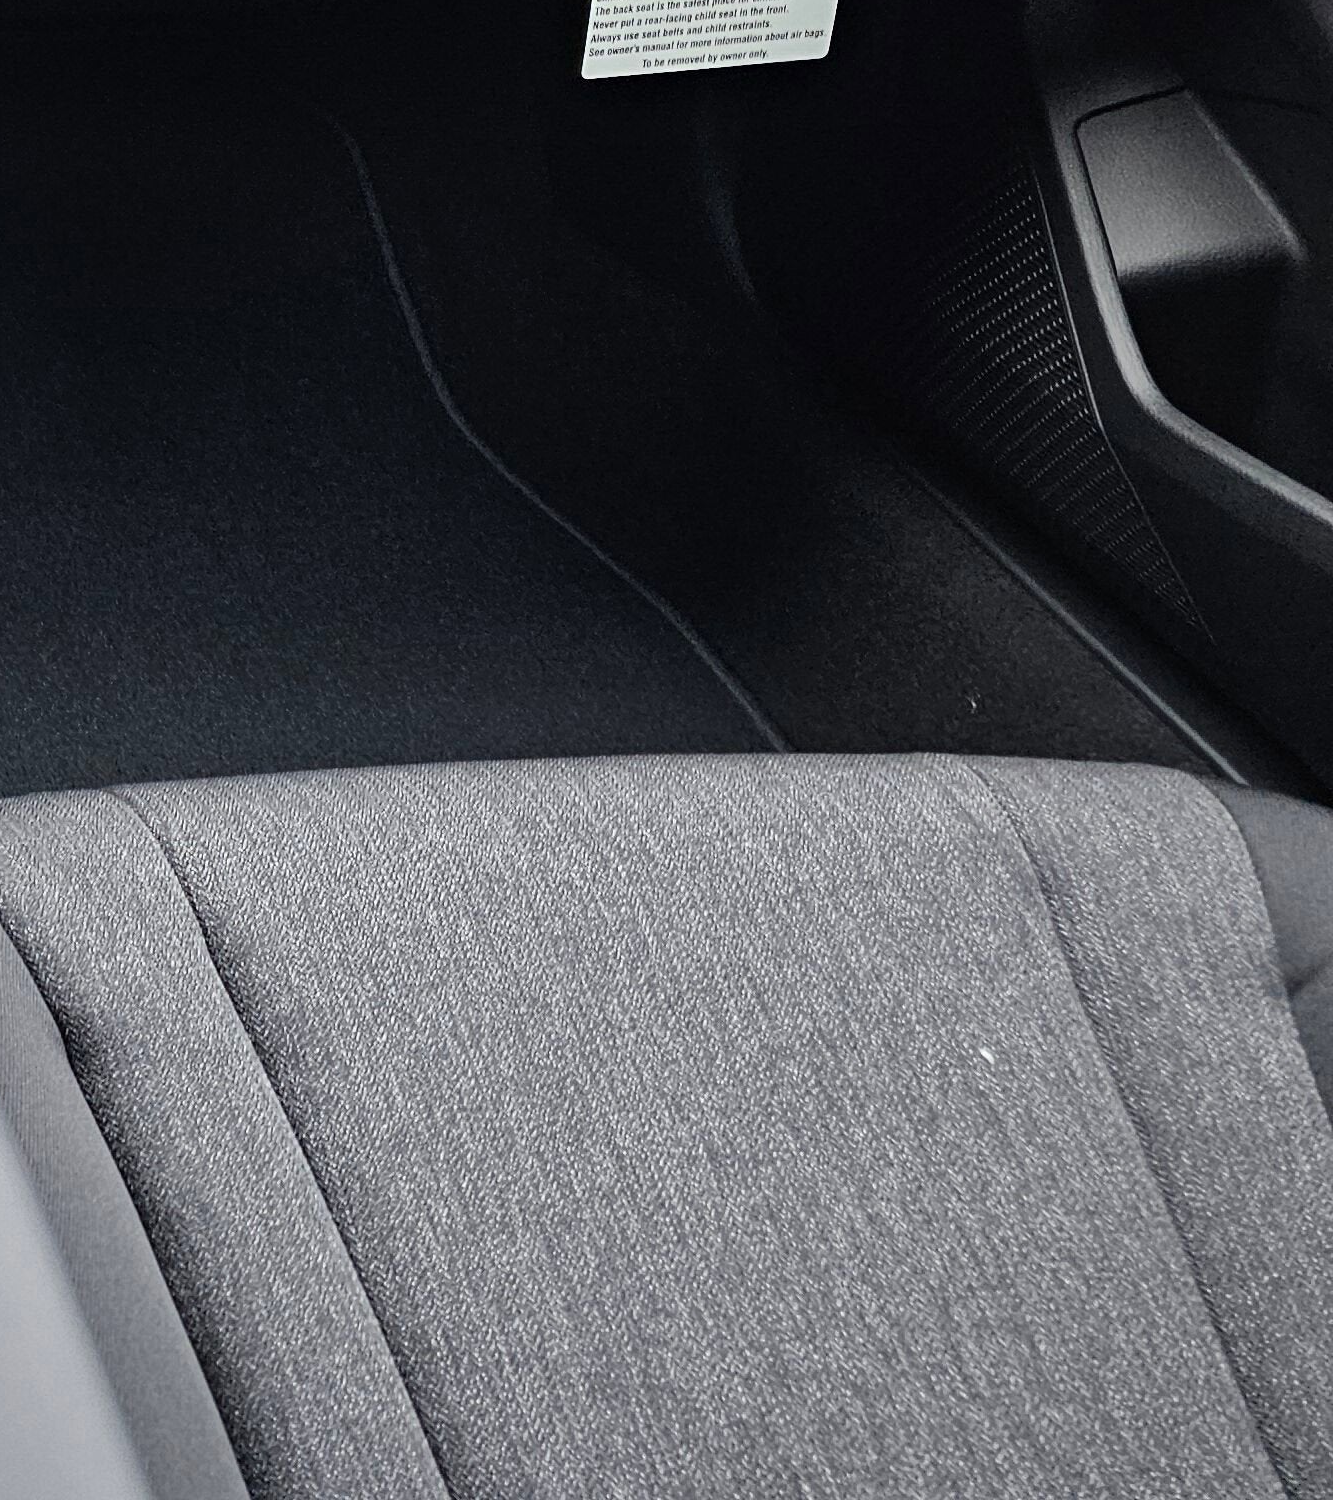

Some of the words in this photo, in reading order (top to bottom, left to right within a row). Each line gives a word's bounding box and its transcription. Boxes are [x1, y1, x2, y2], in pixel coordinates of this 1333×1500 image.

[592, 20, 618, 31] Never
[620, 18, 634, 30] put
[636, 19, 642, 27] a
[644, 13, 693, 27] rear-facing
[694, 11, 717, 21] child
[718, 8, 737, 19] seat
[739, 8, 748, 17] in
[750, 6, 764, 16] the
[595, 6, 611, 17] The
[613, 3, 634, 15] back
[635, 2, 654, 13] seat
[656, 2, 665, 11] is
[667, 0, 681, 10] the
[588, 47, 605, 57] See
[607, 43, 640, 56] owner's
[642, 41, 674, 53] manual
[676, 40, 688, 50] for
[690, 38, 712, 48] more
[714, 34, 763, 47] information
[764, 31, 789, 42] about
[790, 29, 803, 39] air
[590, 33, 622, 44] Always
[623, 31, 640, 41] use
[641, 29, 661, 40] seat
[662, 27, 684, 38] belts
[686, 25, 703, 35] and
[705, 22, 727, 33] child
[642, 59, 652, 68] To
[654, 57, 665, 67] be
[667, 54, 706, 66] removed
[707, 53, 718, 64] by
[720, 51, 750, 61] owner
